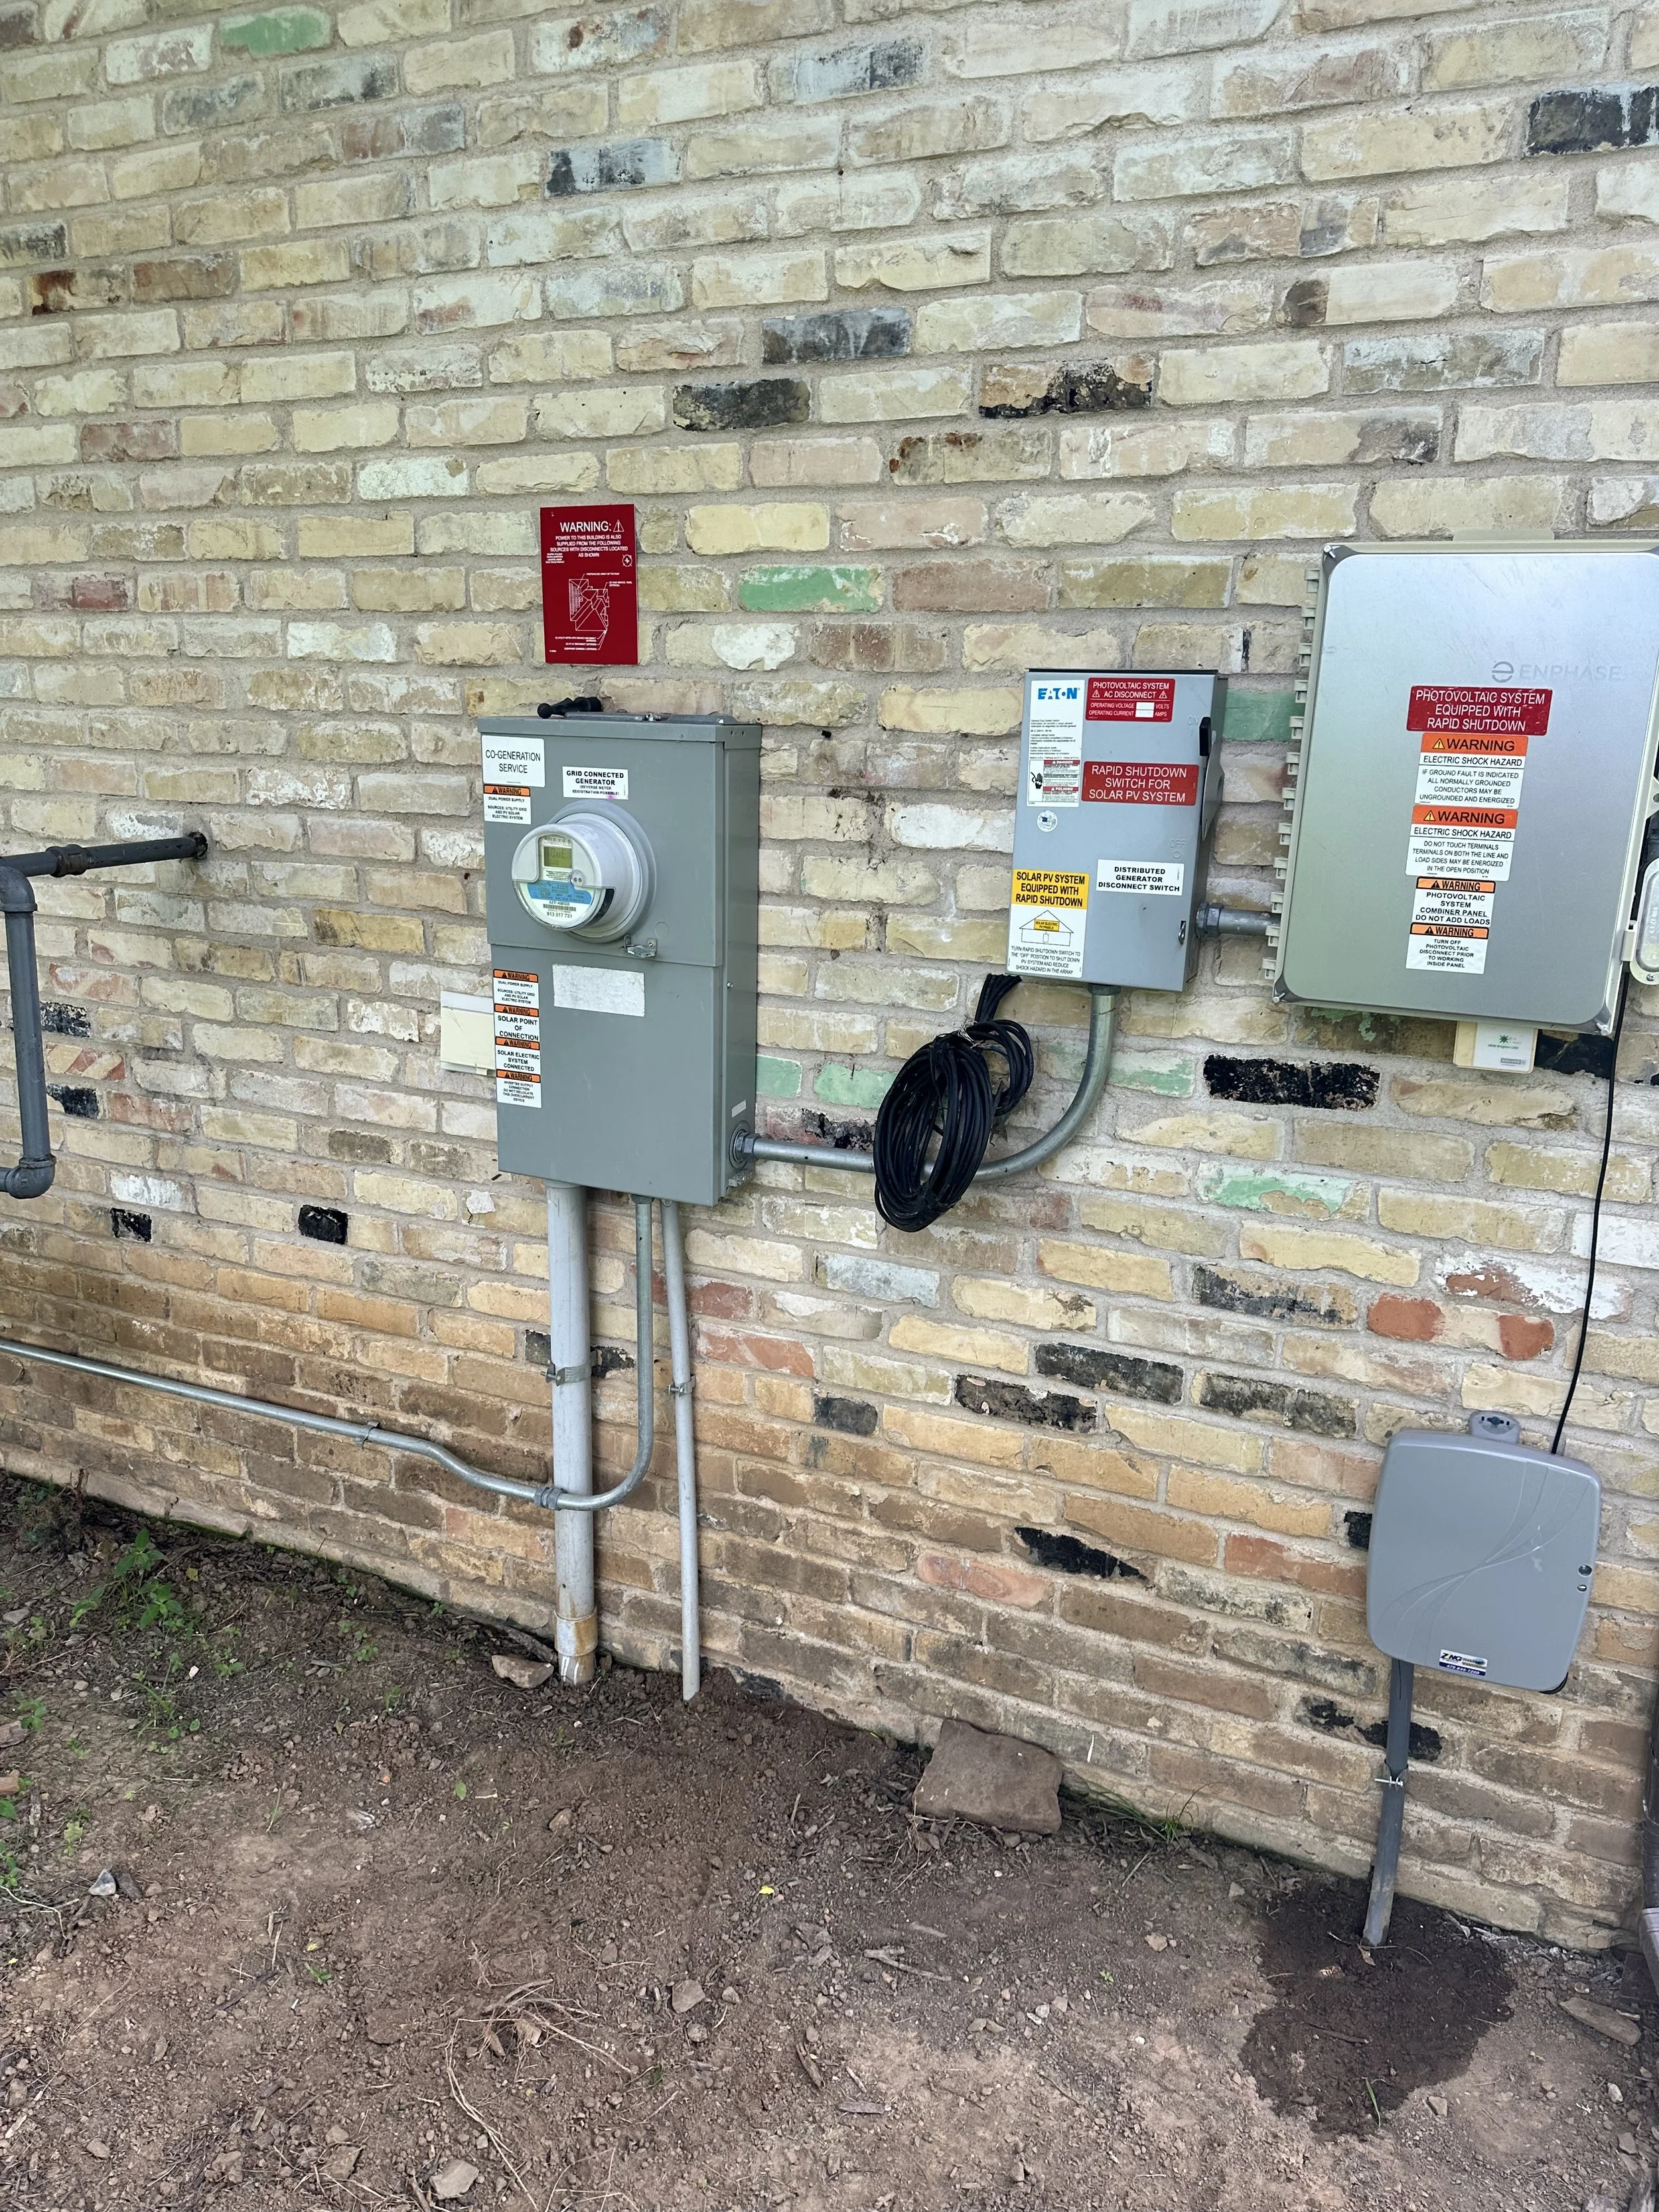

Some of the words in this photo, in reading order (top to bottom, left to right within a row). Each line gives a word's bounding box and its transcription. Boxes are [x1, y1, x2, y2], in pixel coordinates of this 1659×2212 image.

[560, 521, 611, 532] WARNING:
[1520, 666, 1621, 681] ENPHASE
[1038, 688, 1077, 699] EATON
[1416, 691, 1497, 703] PHOTOVOLTAIC
[1500, 692, 1545, 704] SYSTEM
[1435, 705, 1490, 716] EQUIPPED
[1493, 706, 1521, 717] WITH
[1427, 718, 1460, 729] RAPID
[1462, 719, 1525, 731] SHUTDOWN
[1447, 739, 1514, 751] WARNING
[486, 750, 540, 761] CO-GENERATION
[499, 763, 527, 773] SERVICE
[1092, 765, 1122, 775] RAPID
[1125, 766, 1187, 778] SHUTDOWN
[1105, 778, 1145, 788] SWITCH
[1148, 779, 1170, 789] FOR
[1089, 789, 1122, 800] SOLAR
[1126, 791, 1140, 800] PV
[1143, 791, 1185, 802] SYSTEM
[1438, 811, 1505, 824] WARNING
[1414, 827, 1450, 835] ELECTRIC
[1480, 830, 1511, 838] HAZARD
[1017, 872, 1041, 882] SOLAR
[1043, 873, 1053, 882] PV
[1055, 874, 1085, 884] SYSTEM
[1021, 883, 1058, 894] EQUIPPED
[1060, 886, 1078, 895] WITH
[1442, 881, 1480, 891] WARNING
[1016, 894, 1038, 903] RAPID
[1040, 896, 1082, 907] SHUTDOWN
[1426, 892, 1485, 901] PHOTOVOLTAIC
[1436, 927, 1474, 937] WARNING
[500, 1031, 538, 1040] CONNECTION
[504, 1063, 534, 1071] CONNECTED
[510, 1072, 532, 1081] WARNING
